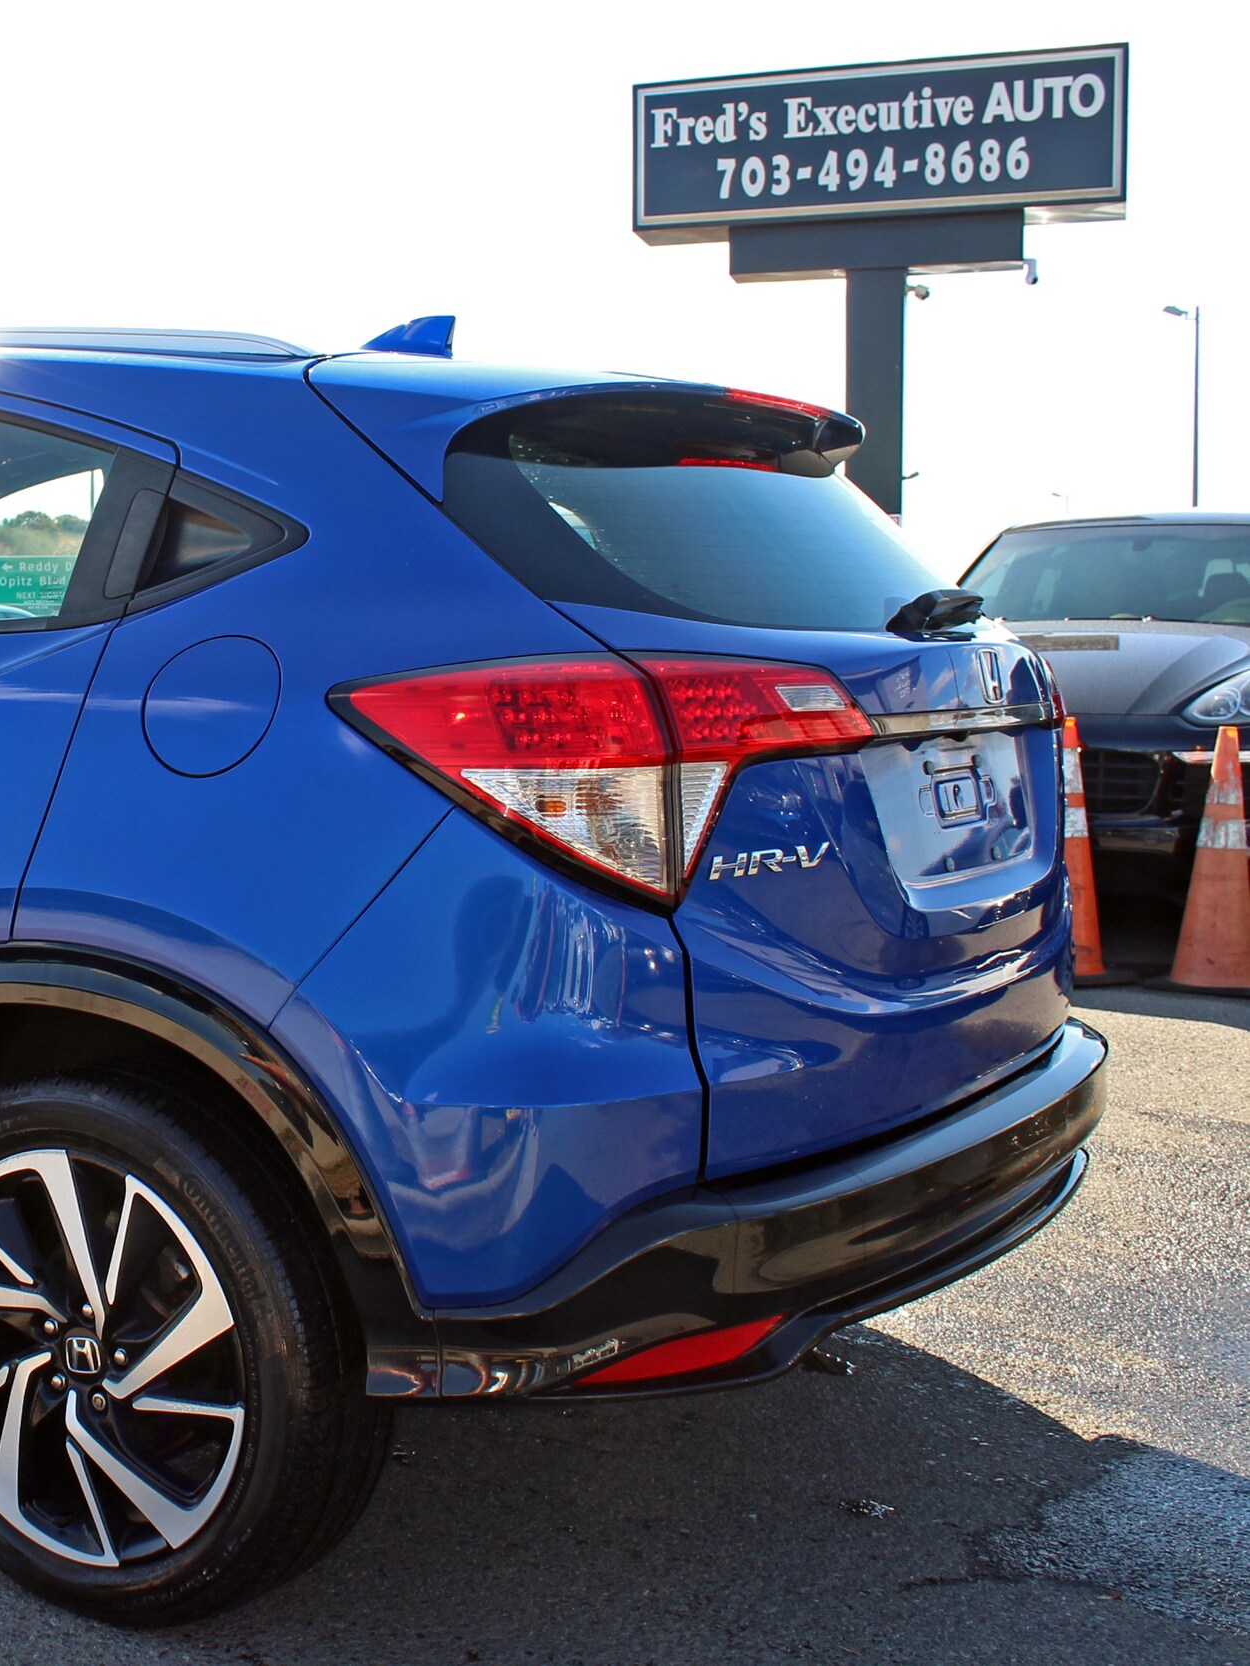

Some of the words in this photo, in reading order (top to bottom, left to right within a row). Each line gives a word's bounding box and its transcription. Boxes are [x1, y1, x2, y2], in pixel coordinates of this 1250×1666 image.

[651, 101, 768, 148] Fred's
[784, 87, 974, 139] Executive
[982, 73, 1105, 124] AUTO
[717, 136, 1030, 199] 703-494-8686
[19, 562, 59, 573] Reddy
[708, 842, 830, 881] HR-V
